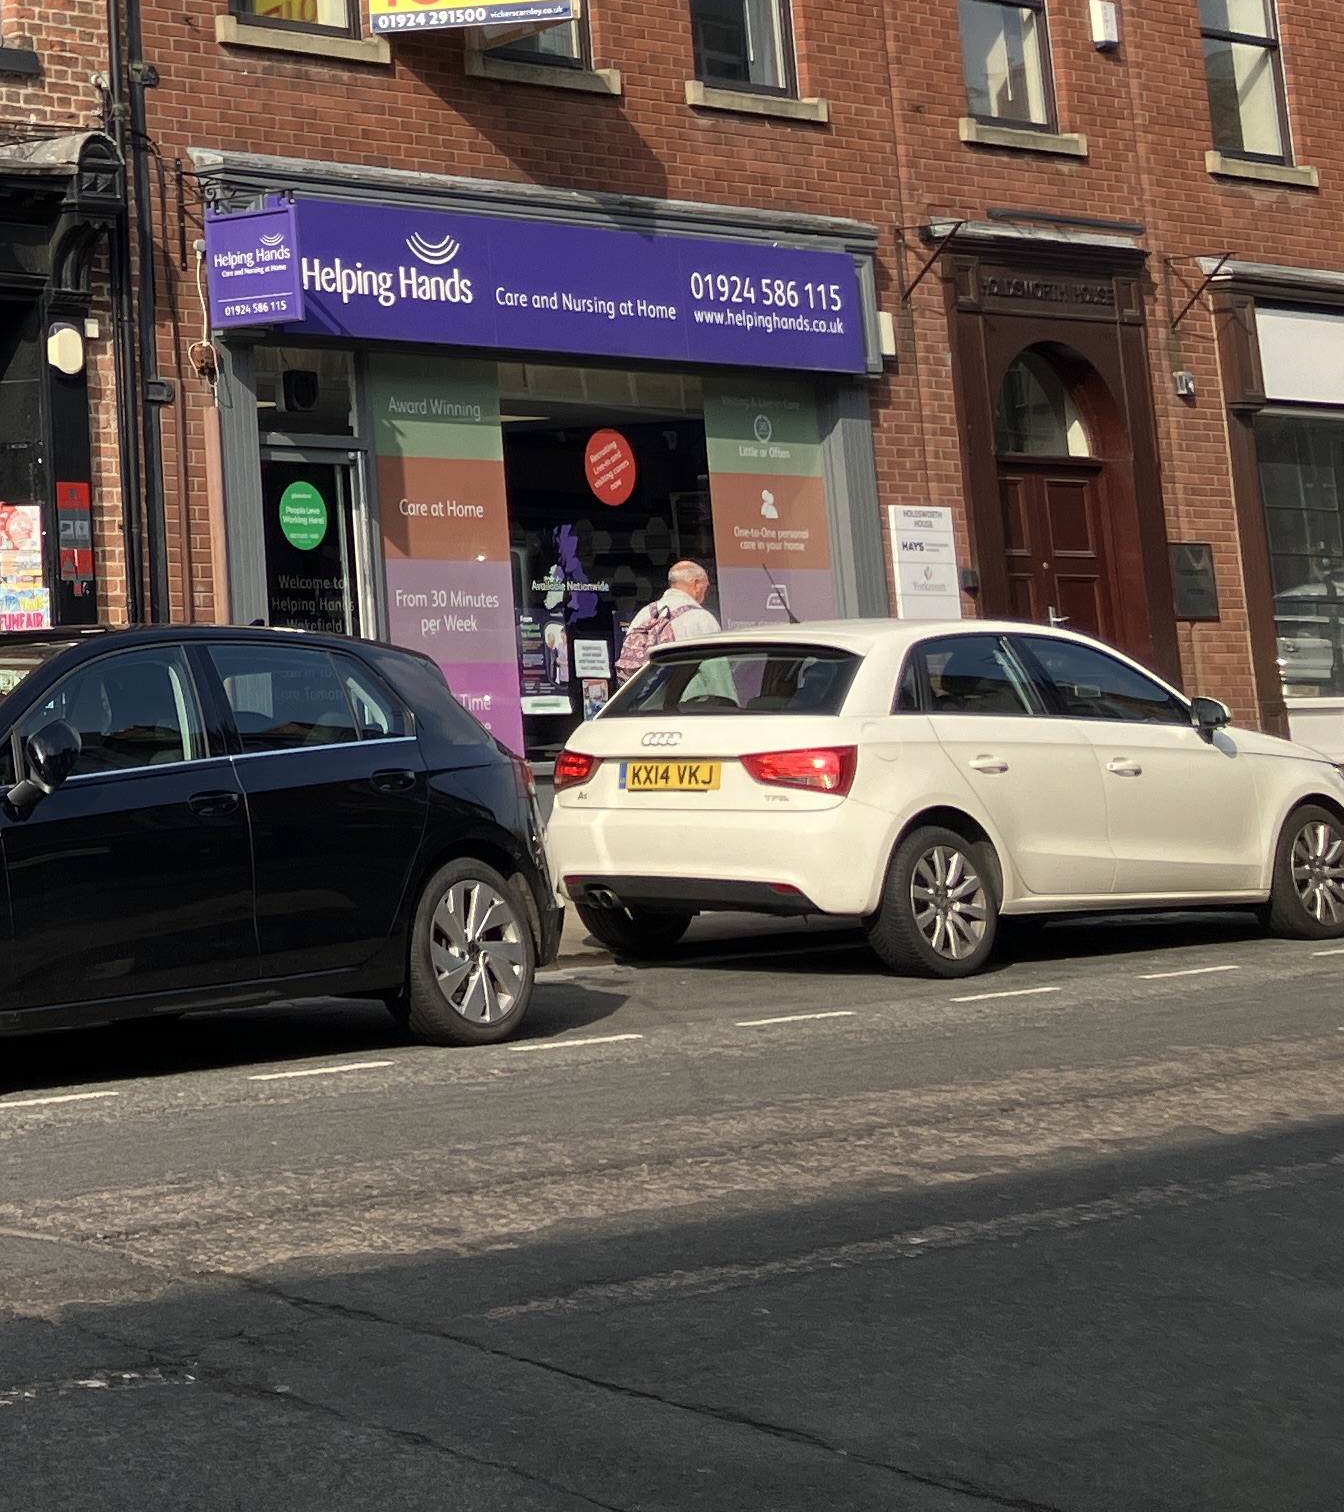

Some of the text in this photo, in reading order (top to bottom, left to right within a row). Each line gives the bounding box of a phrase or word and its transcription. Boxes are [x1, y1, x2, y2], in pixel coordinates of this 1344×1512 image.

[378, 11, 427, 29] 01924
[429, 8, 486, 25] 291500
[214, 245, 291, 269] Helping Hands
[301, 257, 473, 307] Helping Hands
[690, 271, 842, 312] 01924 586 115
[224, 300, 287, 317] 01924 586 115
[495, 286, 676, 320] Care and Nursing at Home
[693, 308, 845, 335] www.helpinghands.co.uk
[389, 396, 481, 421] Award Winning
[739, 446, 790, 458] Little or Often
[399, 498, 484, 518] Care at Home
[734, 526, 809, 541] One-to-One personal
[740, 541, 805, 552] care in your home
[902, 541, 924, 551] HAYS
[278, 575, 346, 589] Welcome to
[532, 580, 610, 592] Available Nationwide
[272, 597, 315, 614] Helping
[395, 590, 499, 608] From 30 Minutes
[0, 612, 43, 631] FUNFAIR
[421, 614, 478, 637] per Week
[460, 693, 492, 711] Time
[631, 765, 714, 785] KX14 VKJ
